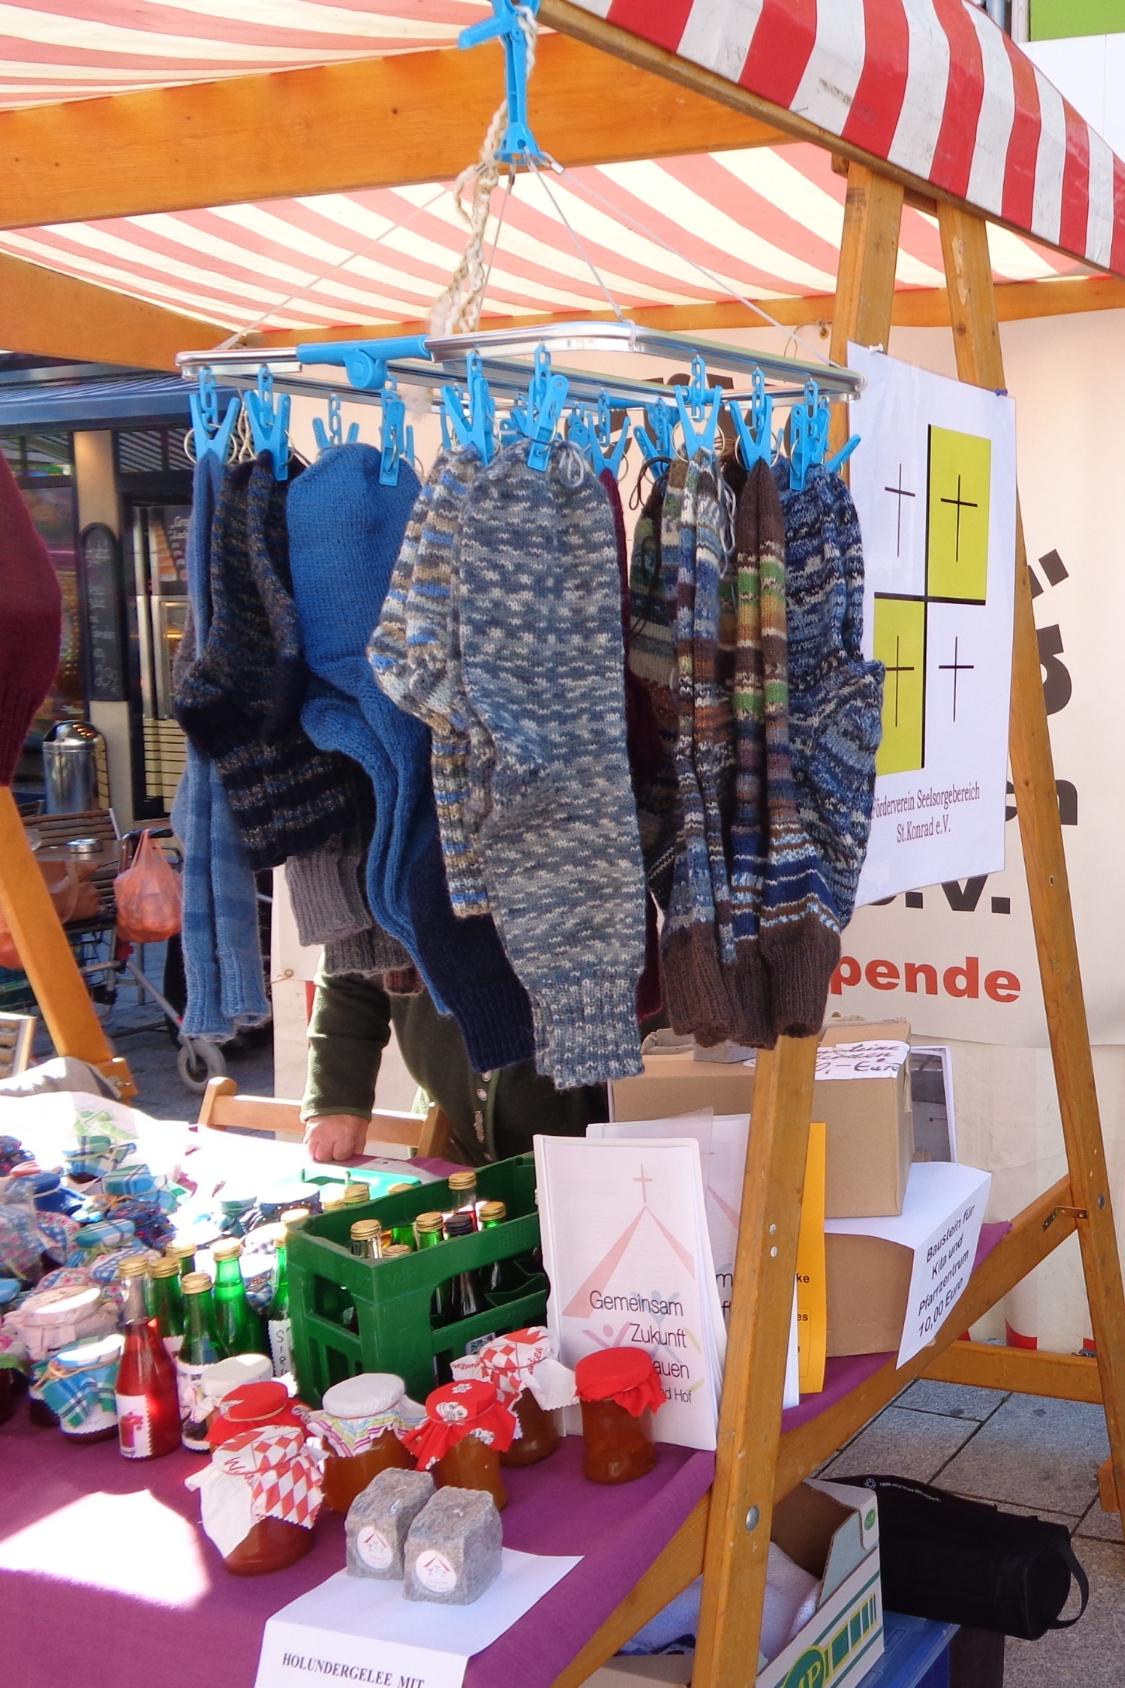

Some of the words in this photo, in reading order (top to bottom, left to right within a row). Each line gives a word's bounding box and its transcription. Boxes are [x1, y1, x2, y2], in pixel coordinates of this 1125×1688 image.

[917, 780, 981, 810] Seelsorgebereich
[936, 813, 951, 835] e.V.
[830, 955, 1021, 1003] pende
[926, 1219, 962, 1263] Baustein
[962, 1204, 976, 1224] für
[931, 1253, 948, 1281] Kita
[948, 1233, 964, 1258] und
[918, 1249, 970, 1317] Pfarrzentrum
[589, 1290, 684, 1317] Gemeinsam
[918, 1301, 944, 1338] 10,00
[945, 1277, 964, 1306] Euro
[630, 1322, 687, 1349] Zukunft
[653, 1360, 690, 1380] auen
[674, 1388, 692, 1405] Hof
[282, 1652, 393, 1686] HOLUNDERGELEE
